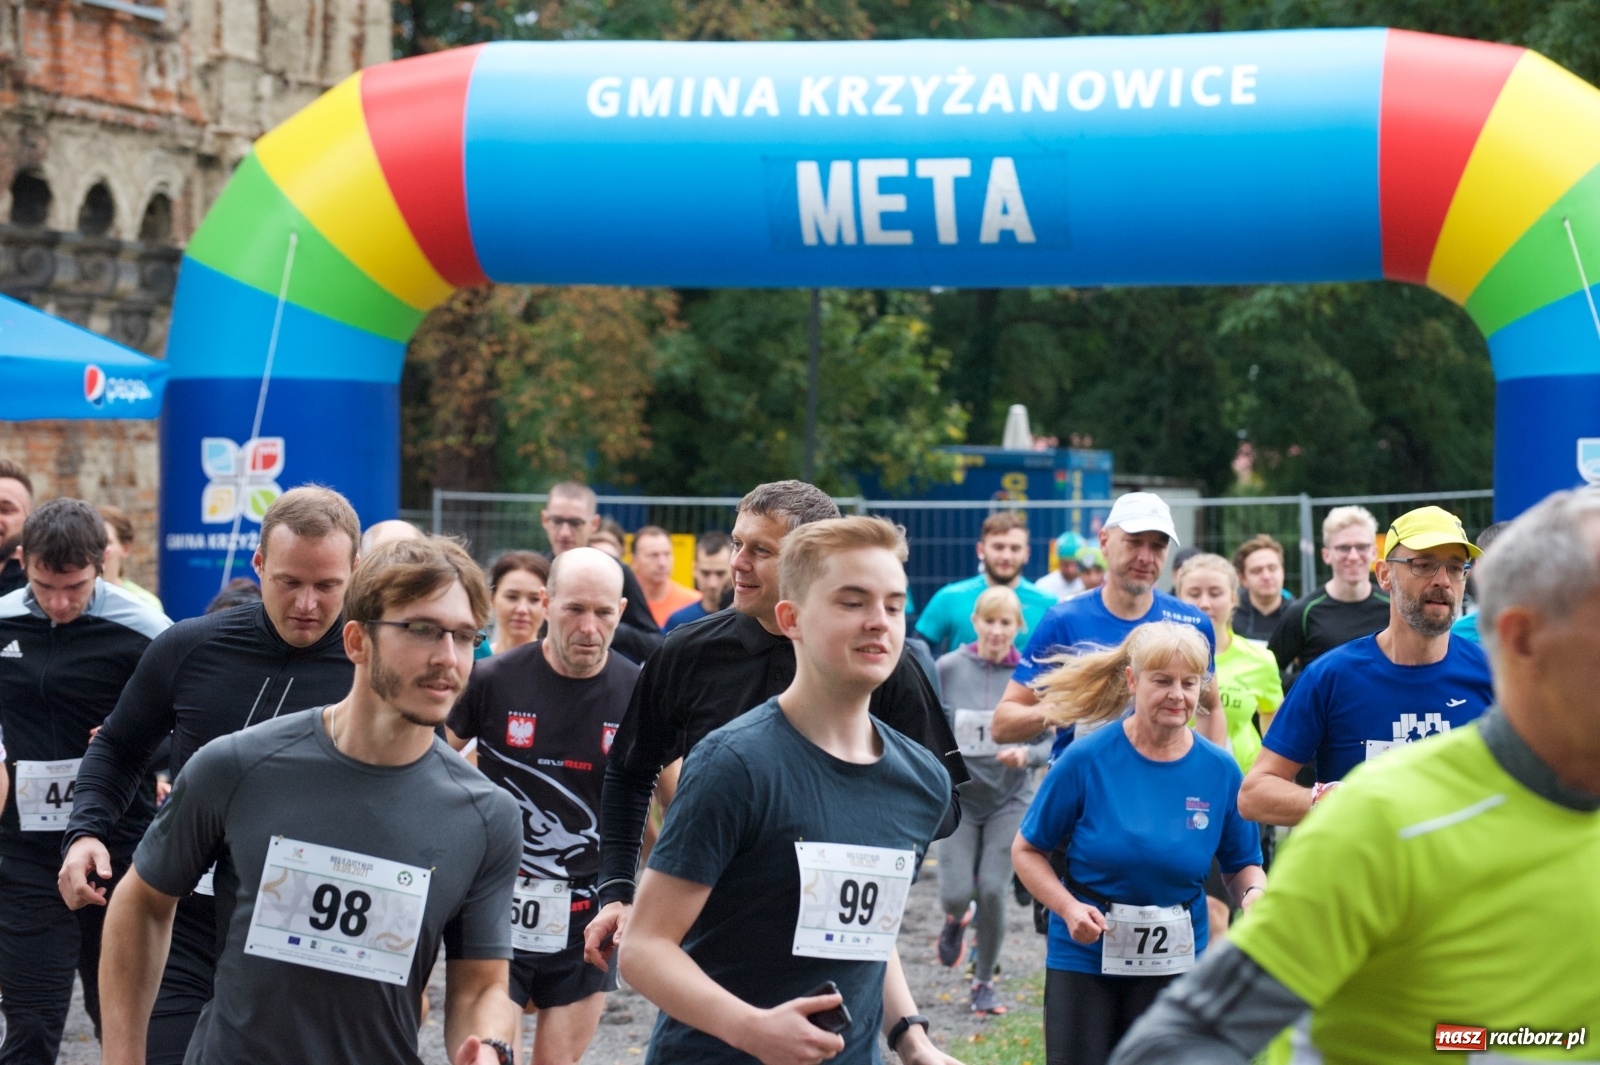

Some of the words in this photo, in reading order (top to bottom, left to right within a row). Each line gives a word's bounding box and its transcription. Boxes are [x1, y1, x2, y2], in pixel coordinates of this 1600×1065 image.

[586, 76, 780, 118] GMINA
[797, 64, 1259, 117] KRZYŻANOWICE
[796, 157, 1037, 246] META
[508, 710, 537, 718] POLSKA
[309, 883, 372, 937] 98
[838, 879, 879, 926] 99
[1133, 926, 1168, 955] 72
